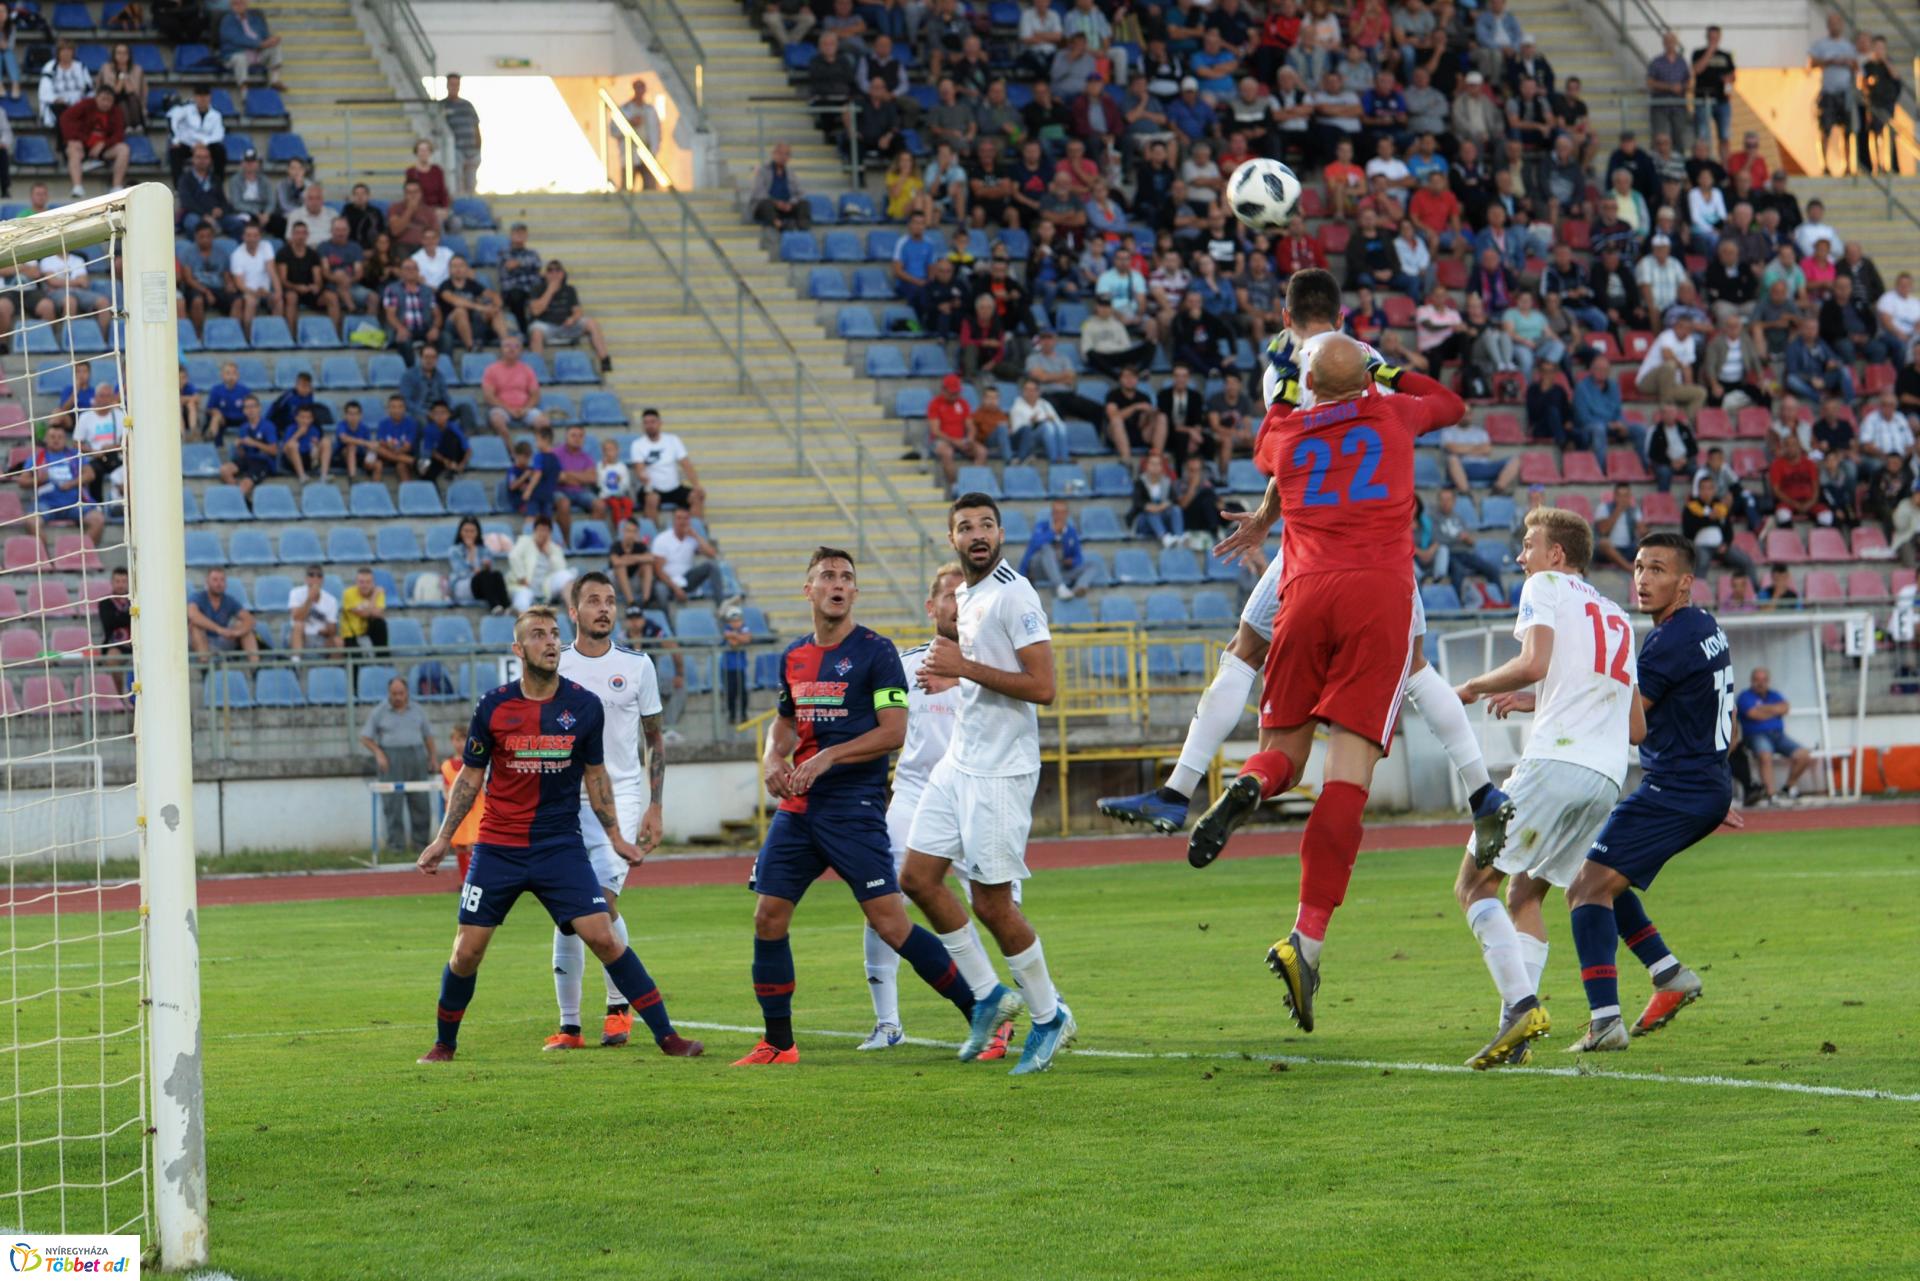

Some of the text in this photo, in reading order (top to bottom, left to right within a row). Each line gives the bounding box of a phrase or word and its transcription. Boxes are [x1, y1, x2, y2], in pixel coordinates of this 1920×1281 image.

[1292, 425, 1389, 506] 22
[1585, 602, 1631, 688] 12
[889, 690, 903, 703] C
[461, 882, 483, 913] 48
[866, 878, 885, 888] JAKO
